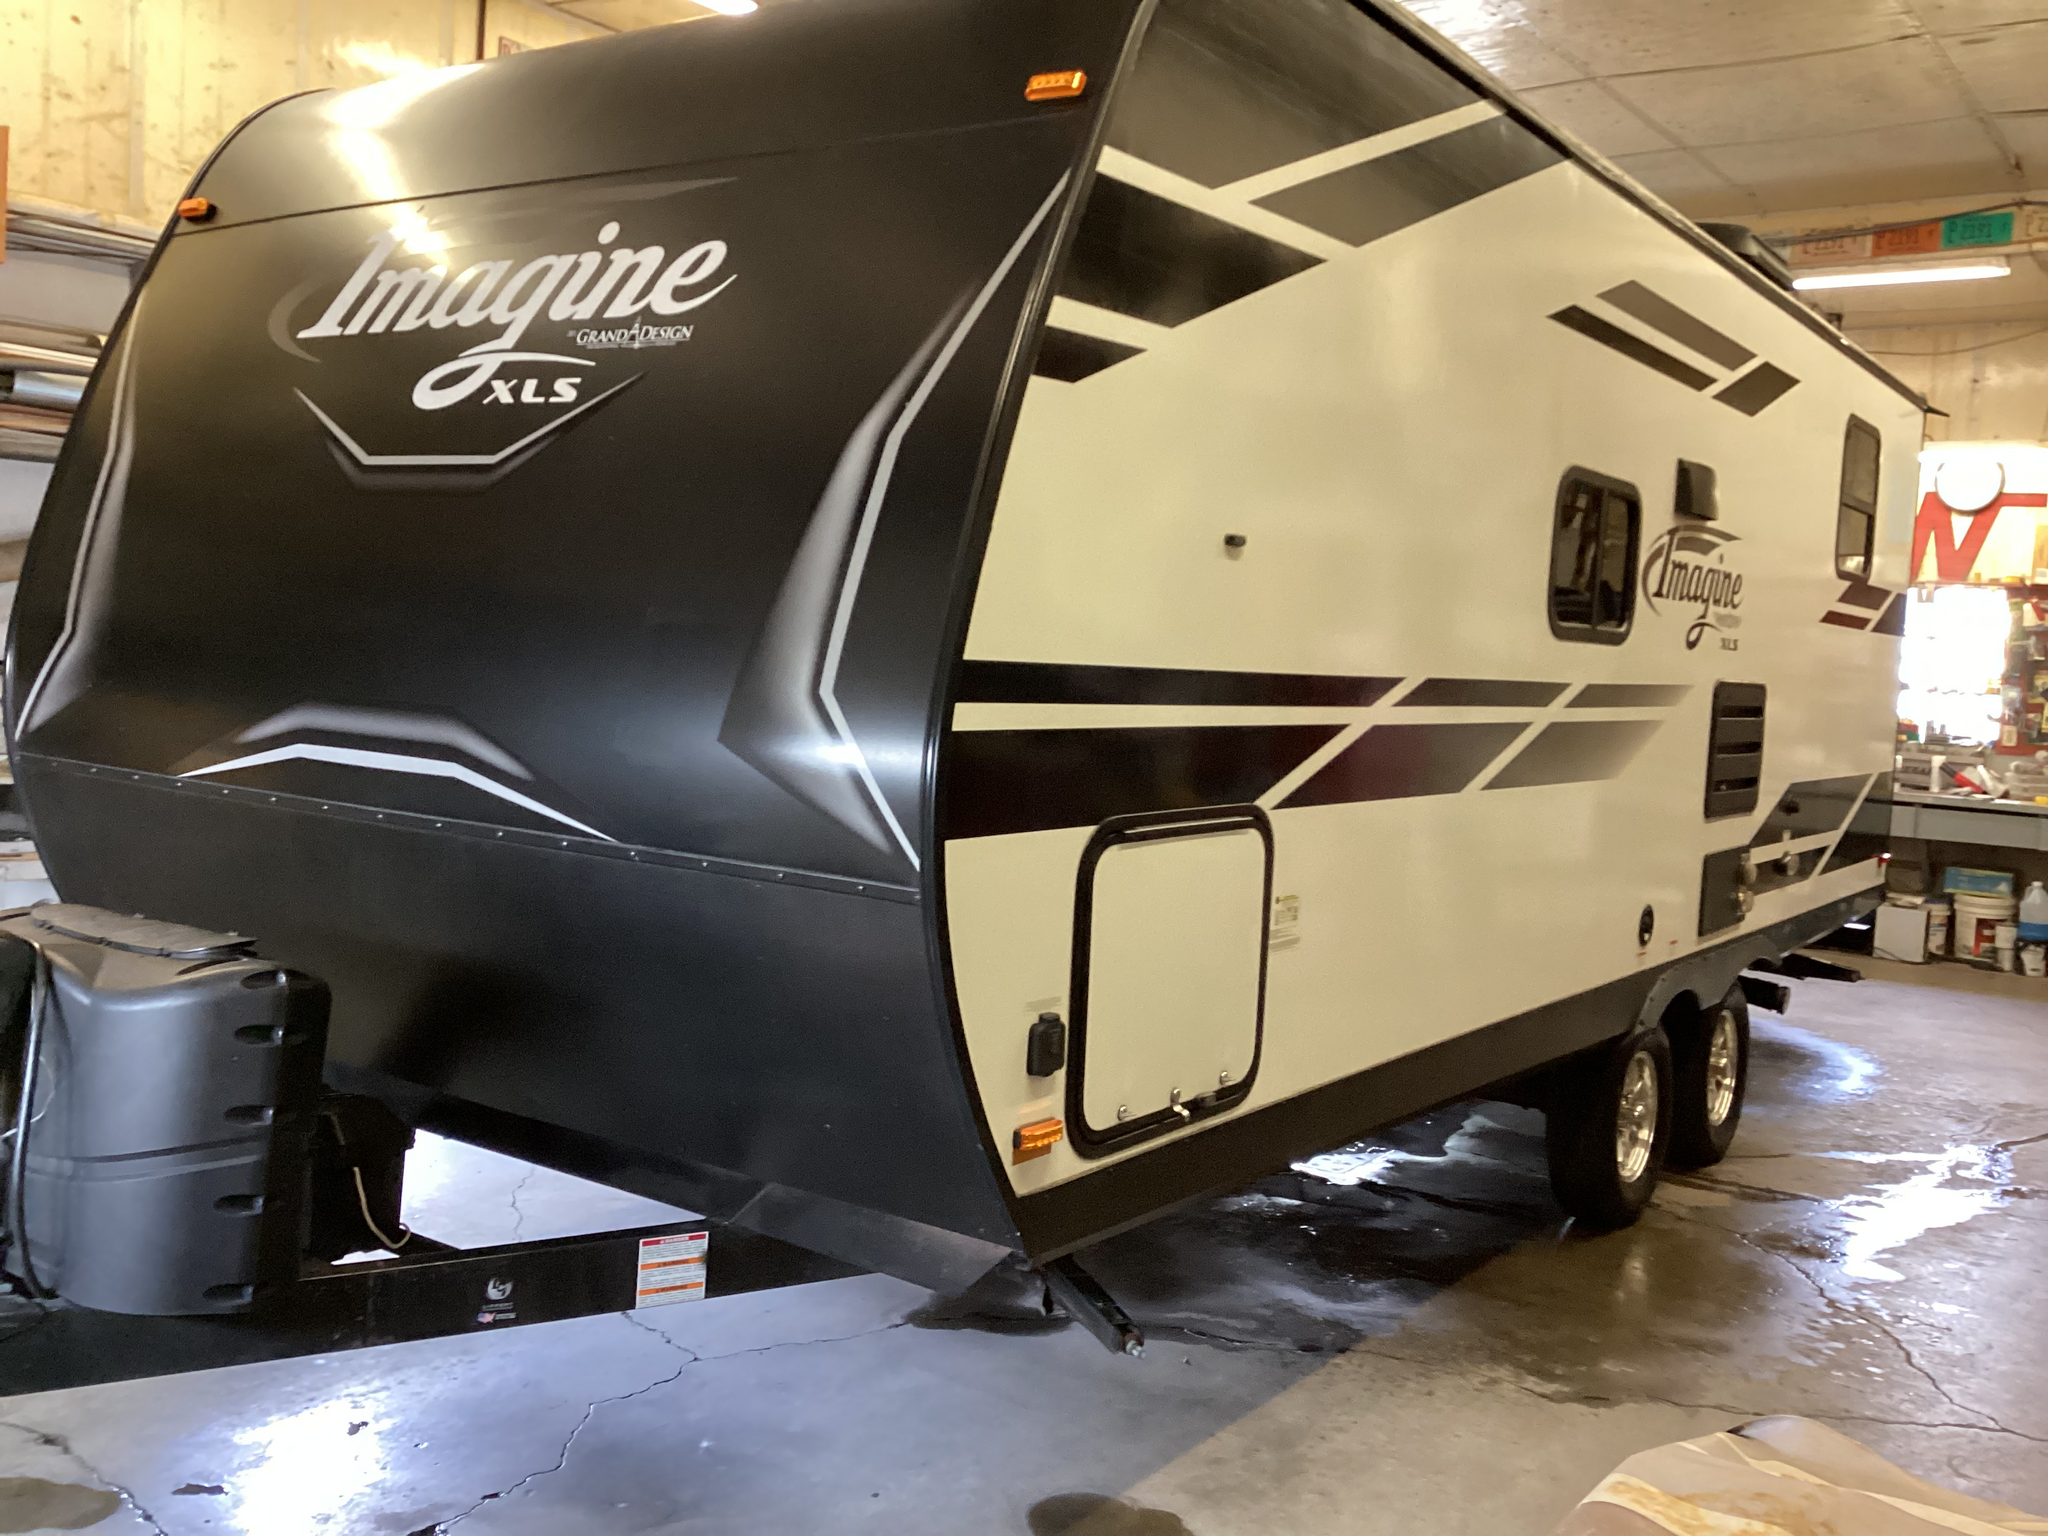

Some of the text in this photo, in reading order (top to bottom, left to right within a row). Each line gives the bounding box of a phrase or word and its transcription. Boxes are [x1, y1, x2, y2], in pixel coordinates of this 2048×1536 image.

[296, 221, 738, 410] Imagine
[576, 328, 628, 344] GRAND
[640, 325, 694, 341] DESIGN
[482, 377, 583, 404] XLS
[1652, 527, 1744, 650] Imagine
